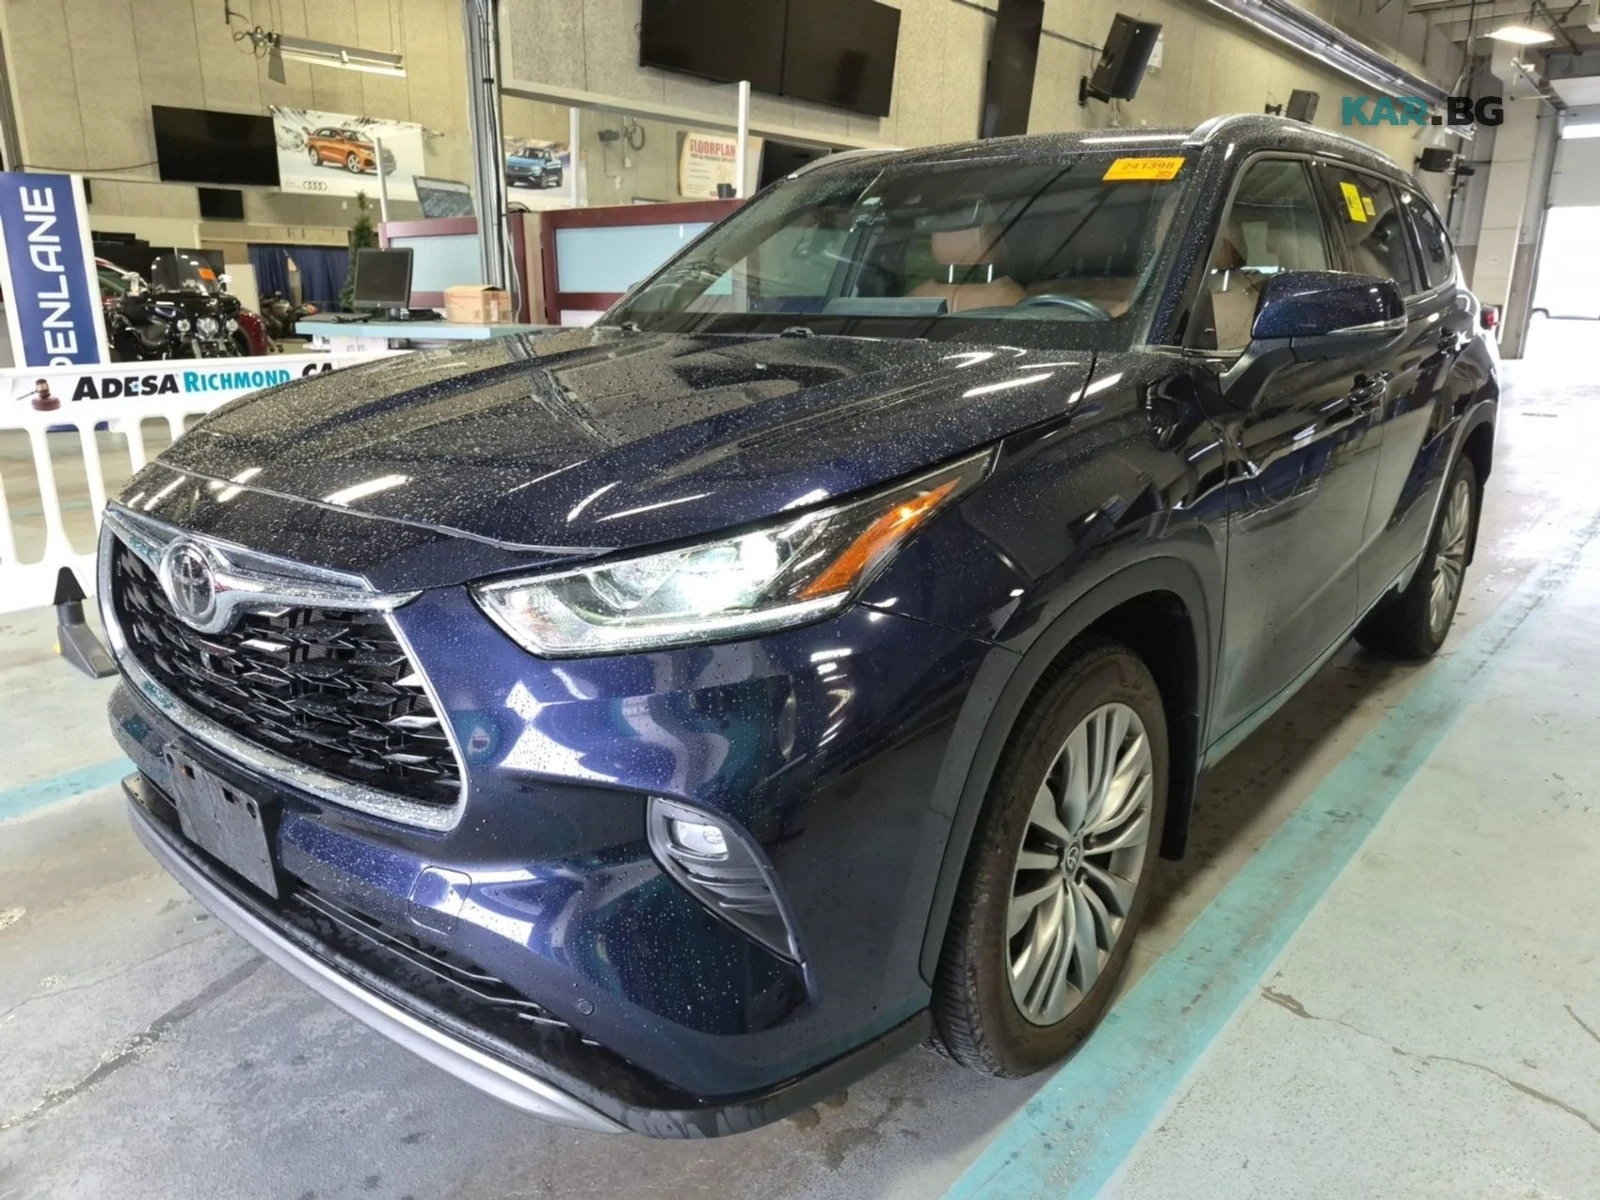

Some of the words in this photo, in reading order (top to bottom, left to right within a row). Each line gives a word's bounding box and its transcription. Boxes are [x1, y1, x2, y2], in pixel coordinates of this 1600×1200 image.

[690, 139, 736, 157] FLOORPLAN
[73, 374, 180, 401] ADESA
[183, 369, 291, 393] RICHMOND
